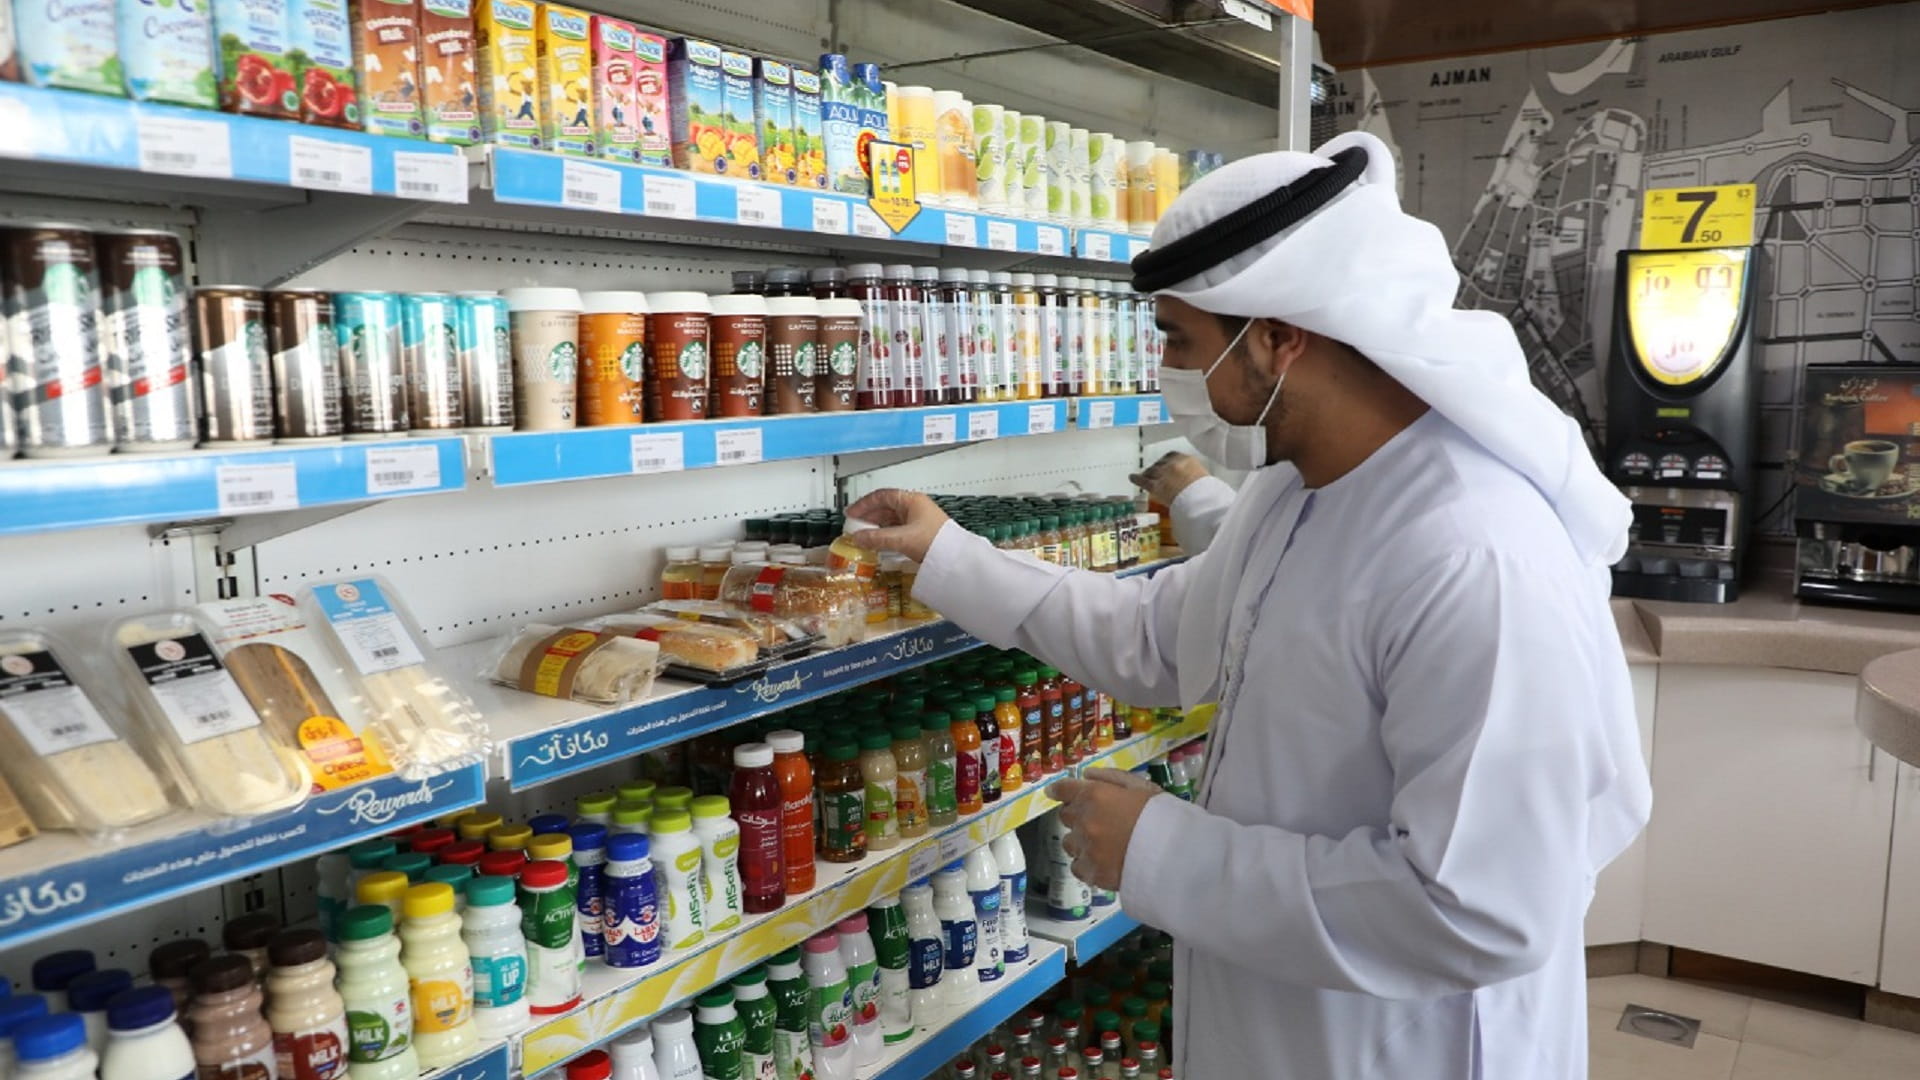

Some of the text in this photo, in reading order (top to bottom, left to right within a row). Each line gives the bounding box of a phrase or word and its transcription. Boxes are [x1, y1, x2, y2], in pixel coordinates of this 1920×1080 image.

[1658, 45, 1742, 63] ARABIAN GULF
[1430, 67, 1491, 88] AJMAN
[829, 105, 858, 121] AQU
[863, 113, 887, 129] AQU
[1676, 191, 1717, 243] 7
[735, 669, 813, 704] Rewards
[519, 730, 609, 769] مكافآت
[316, 777, 454, 825] Rewards
[502, 969, 519, 988] UP
[353, 1026, 385, 1044] MILK
[713, 1036, 746, 1054] ACTIV
[308, 1044, 339, 1068] MILK
